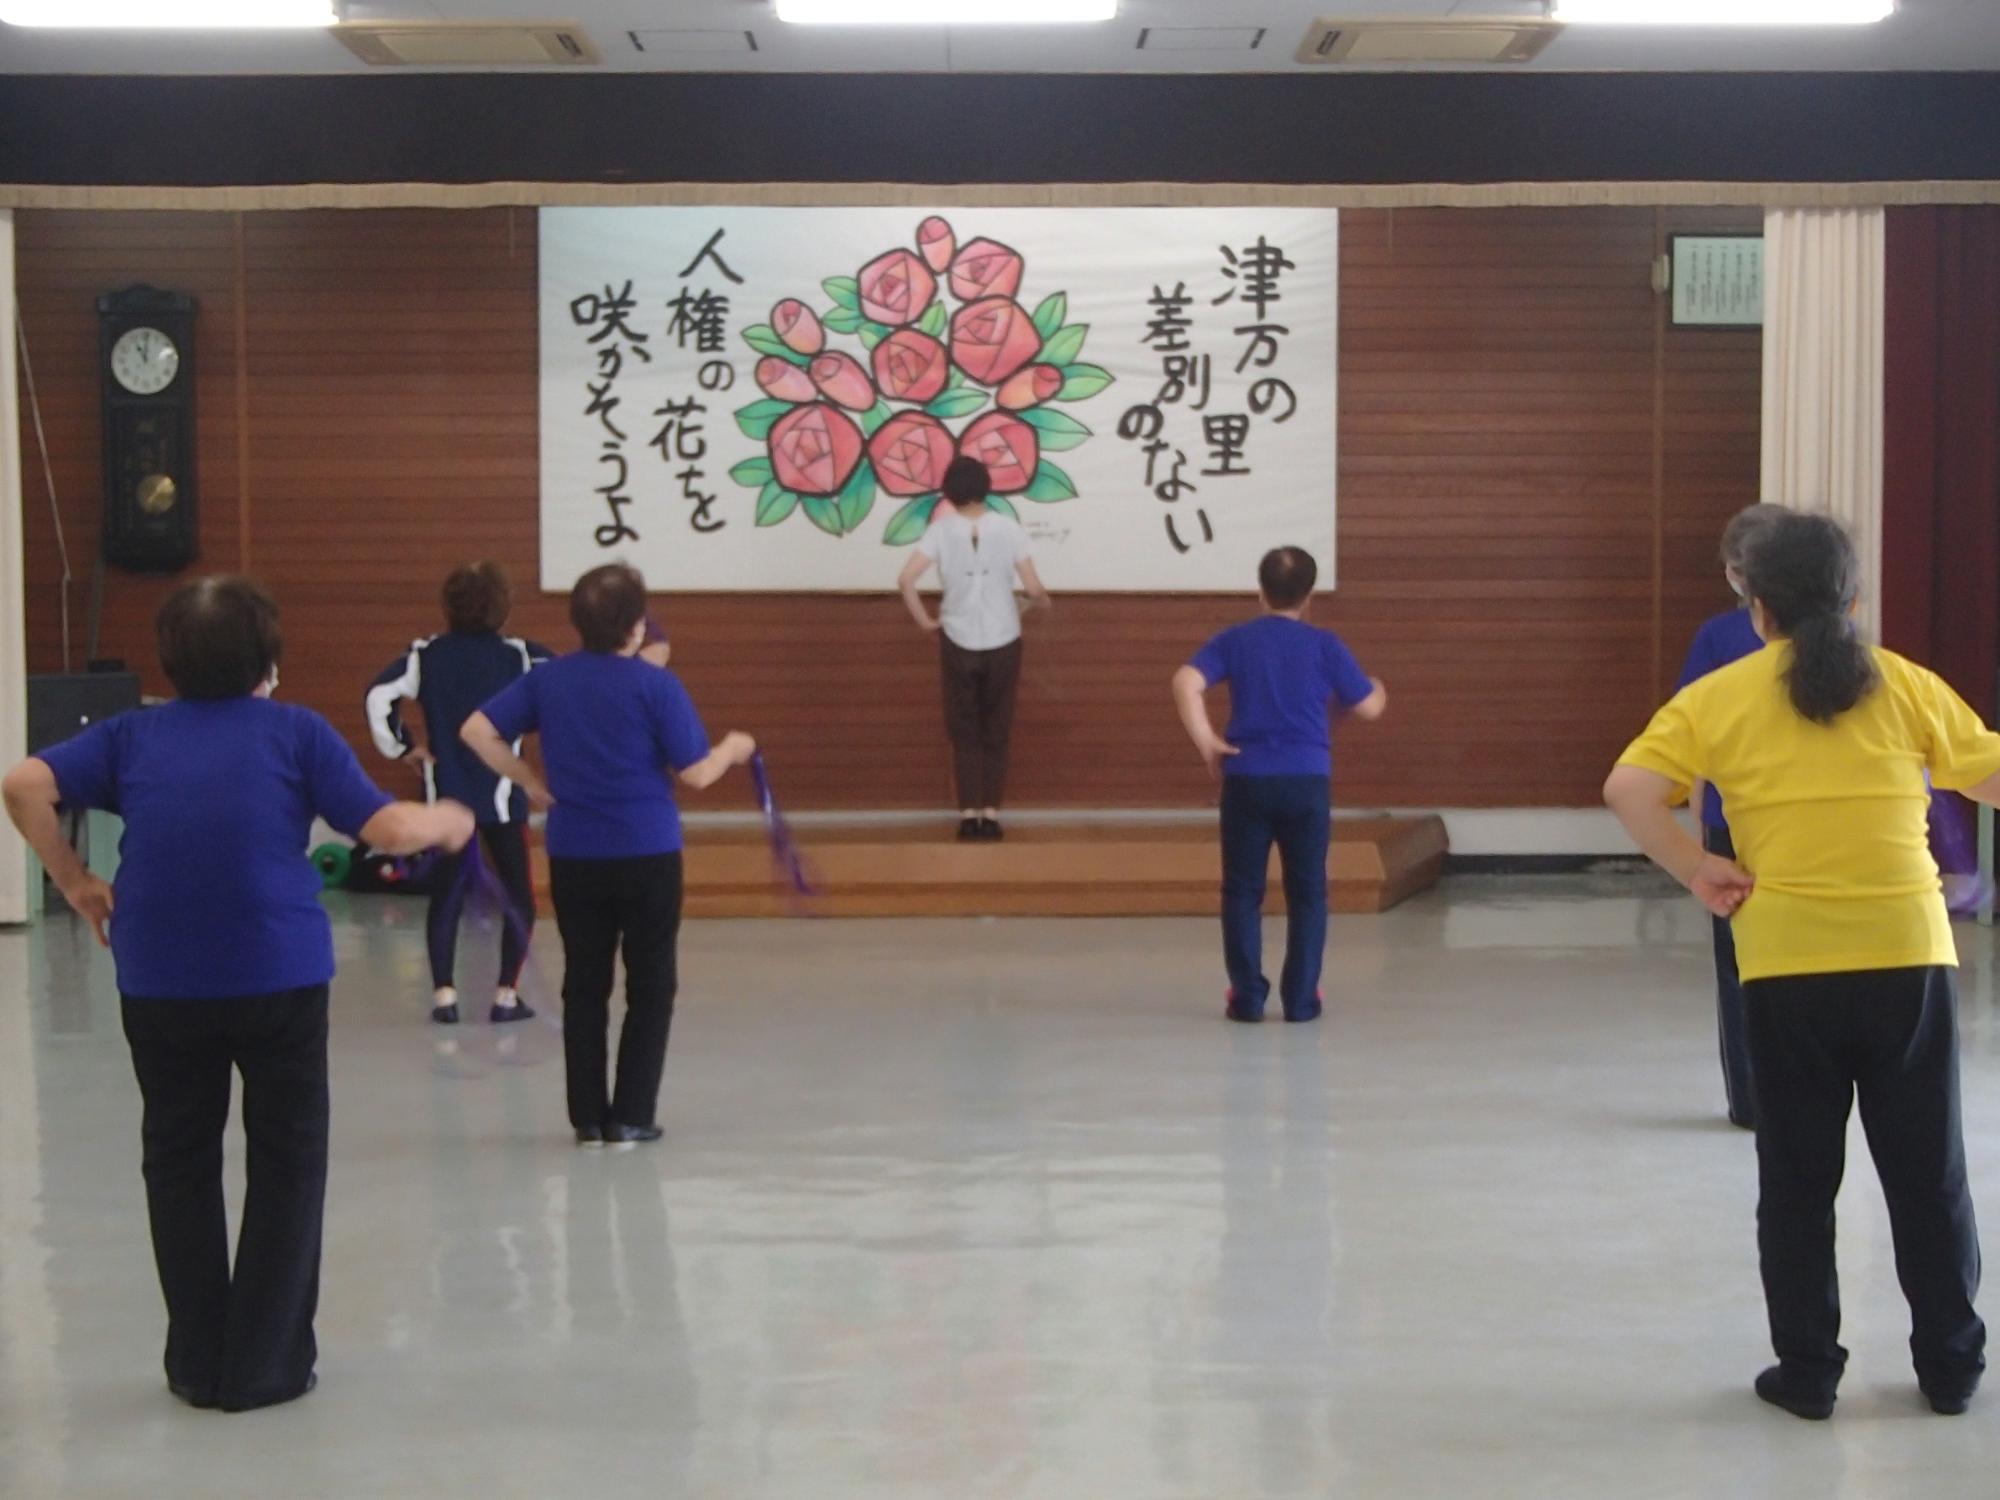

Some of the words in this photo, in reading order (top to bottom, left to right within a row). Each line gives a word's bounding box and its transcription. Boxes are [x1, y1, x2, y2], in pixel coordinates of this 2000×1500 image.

[570, 280, 651, 547] 咲かそうよ
[649, 228, 744, 532] 人権の花を
[1117, 282, 1213, 554] 差別のない
[1202, 236, 1296, 476] 津万の里
